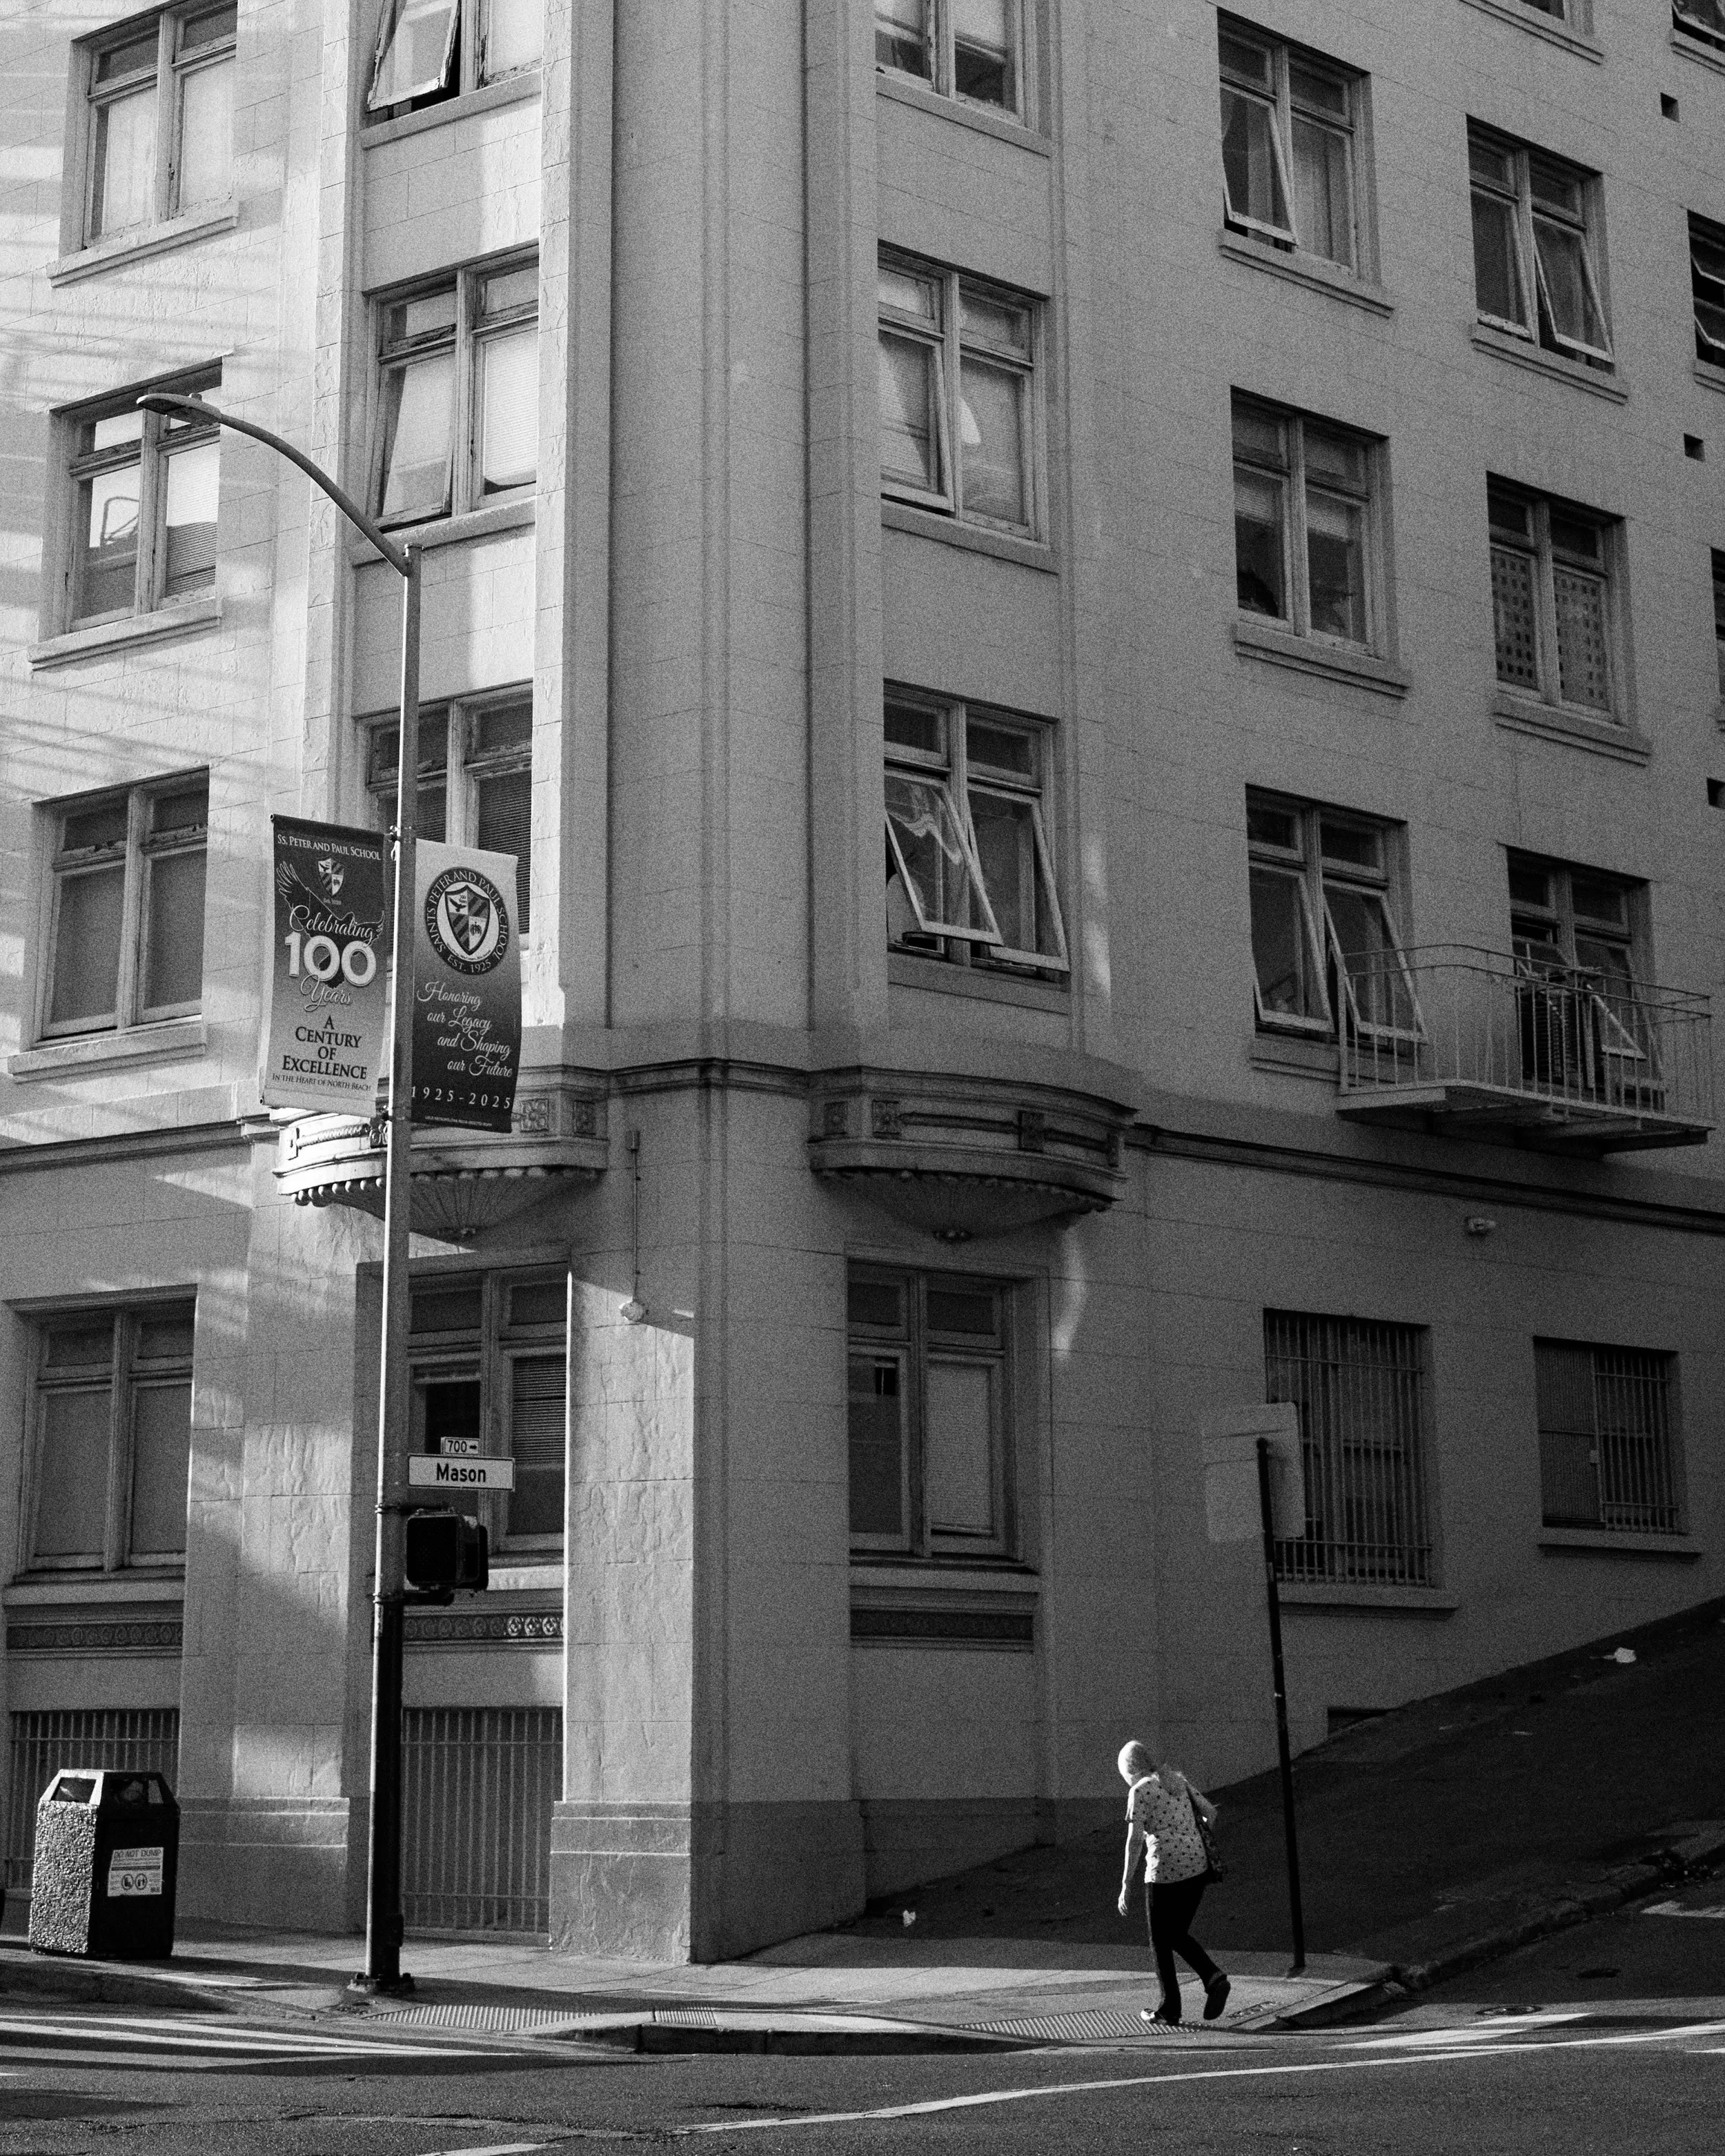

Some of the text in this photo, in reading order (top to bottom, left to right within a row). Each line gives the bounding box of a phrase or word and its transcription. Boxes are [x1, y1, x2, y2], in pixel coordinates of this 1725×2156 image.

[290, 836, 312, 849] PETER
[312, 842, 330, 852] AND
[331, 843, 350, 856] PAUL
[351, 847, 382, 860] SCHOOL
[453, 870, 477, 882] AND
[428, 874, 453, 904] PETER
[479, 878, 501, 907] PAUL
[290, 904, 374, 948] Celebrating
[427, 907, 446, 953] SAINTS
[492, 907, 509, 960] SCHOOL
[285, 931, 376, 987] 100
[471, 959, 492, 973] 1925
[301, 973, 352, 1012] Years
[417, 981, 482, 1011] Honoring
[324, 1015, 335, 1030] A
[426, 1005, 493, 1035] our Legacy
[295, 1026, 362, 1048] CENTURY
[437, 1030, 511, 1060] and Shaping
[317, 1046, 337, 1060] OF
[282, 1055, 367, 1080] EXCELLENCE
[447, 1055, 513, 1077] our Future
[282, 1074, 295, 1082] THE
[295, 1076, 316, 1085] HEART
[327, 1080, 350, 1089] NORTH
[351, 1082, 371, 1091] BEACH
[447, 1440, 467, 1452] 700
[436, 1462, 486, 1483] Mason
